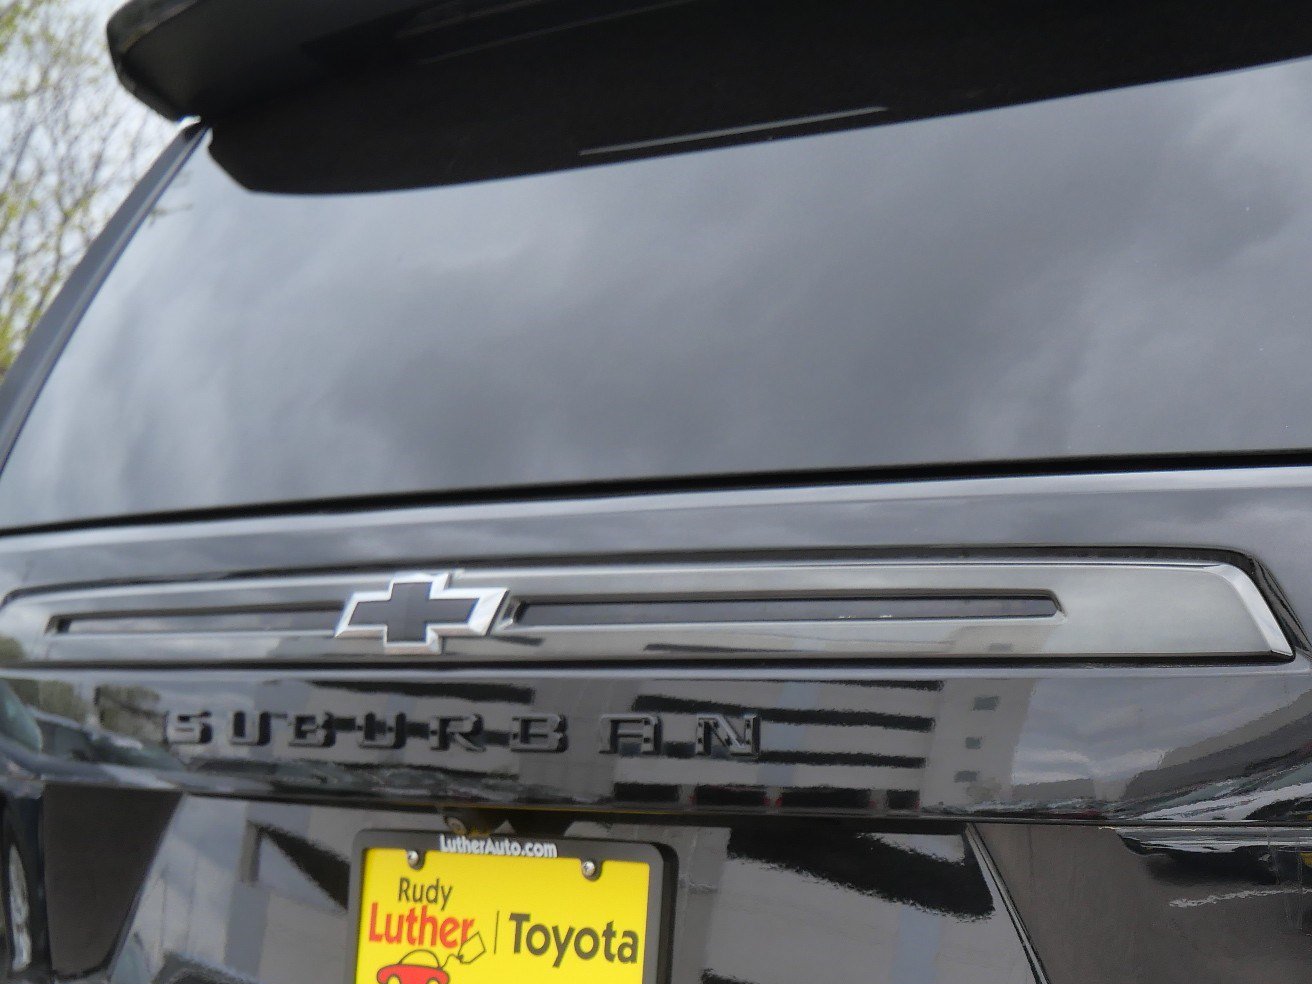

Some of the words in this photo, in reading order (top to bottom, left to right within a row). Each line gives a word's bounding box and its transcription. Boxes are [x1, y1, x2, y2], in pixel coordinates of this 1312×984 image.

[165, 708, 761, 757] SUBURBAN
[439, 834, 557, 857] LutherAuto.com
[398, 877, 453, 911] Rudy
[369, 903, 475, 949] Luther
[509, 912, 640, 968] Toyota
